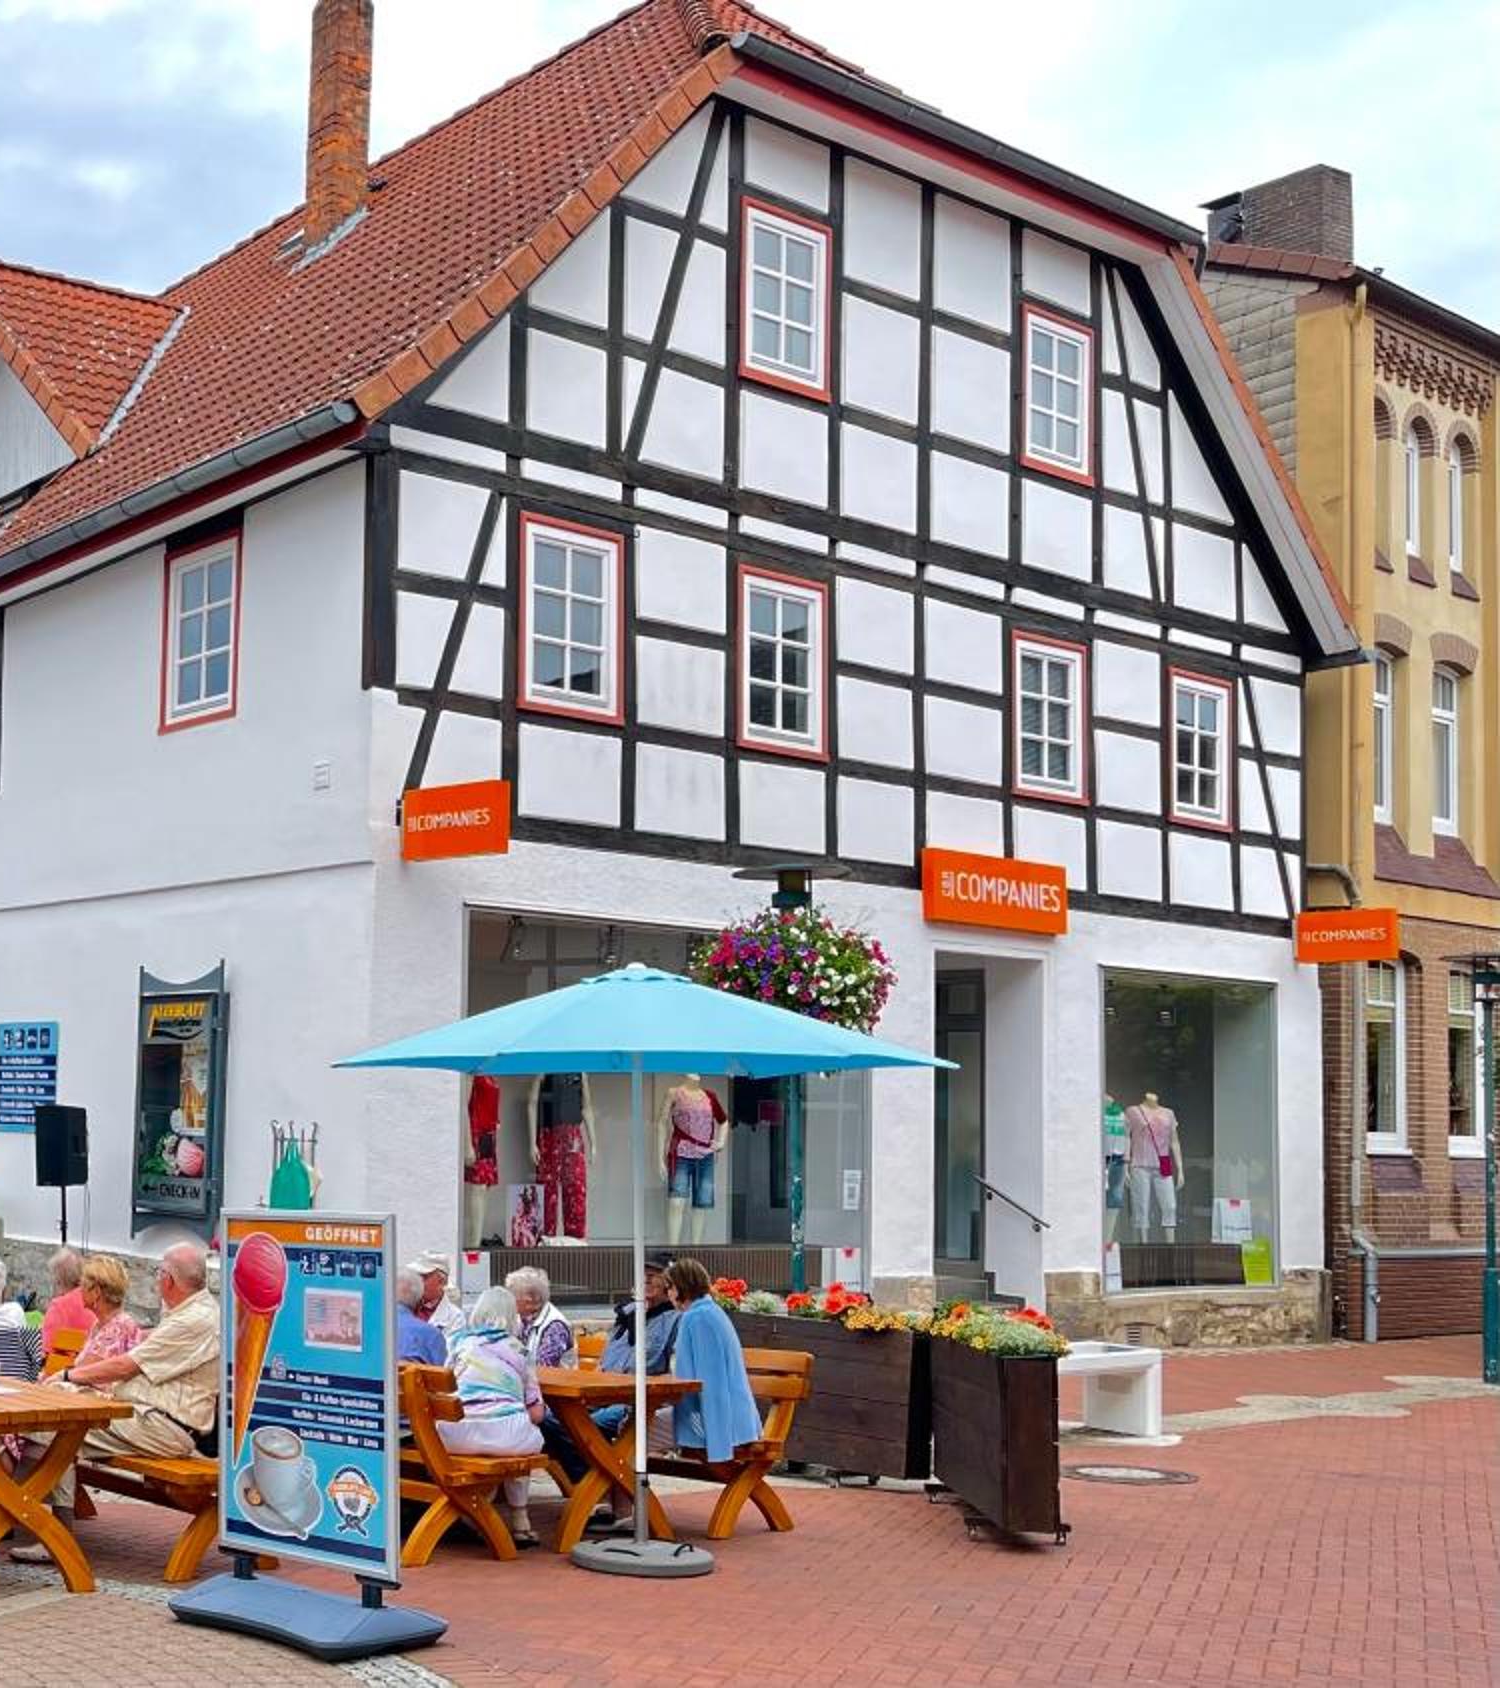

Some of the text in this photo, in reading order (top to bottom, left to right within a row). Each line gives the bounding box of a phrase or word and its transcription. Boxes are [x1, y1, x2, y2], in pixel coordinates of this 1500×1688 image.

[417, 807, 491, 832] COMPANIES
[956, 871, 1060, 913] COMPANIES
[1311, 927, 1388, 943] COMPANIES
[305, 1224, 378, 1243] GEÖFFNET
